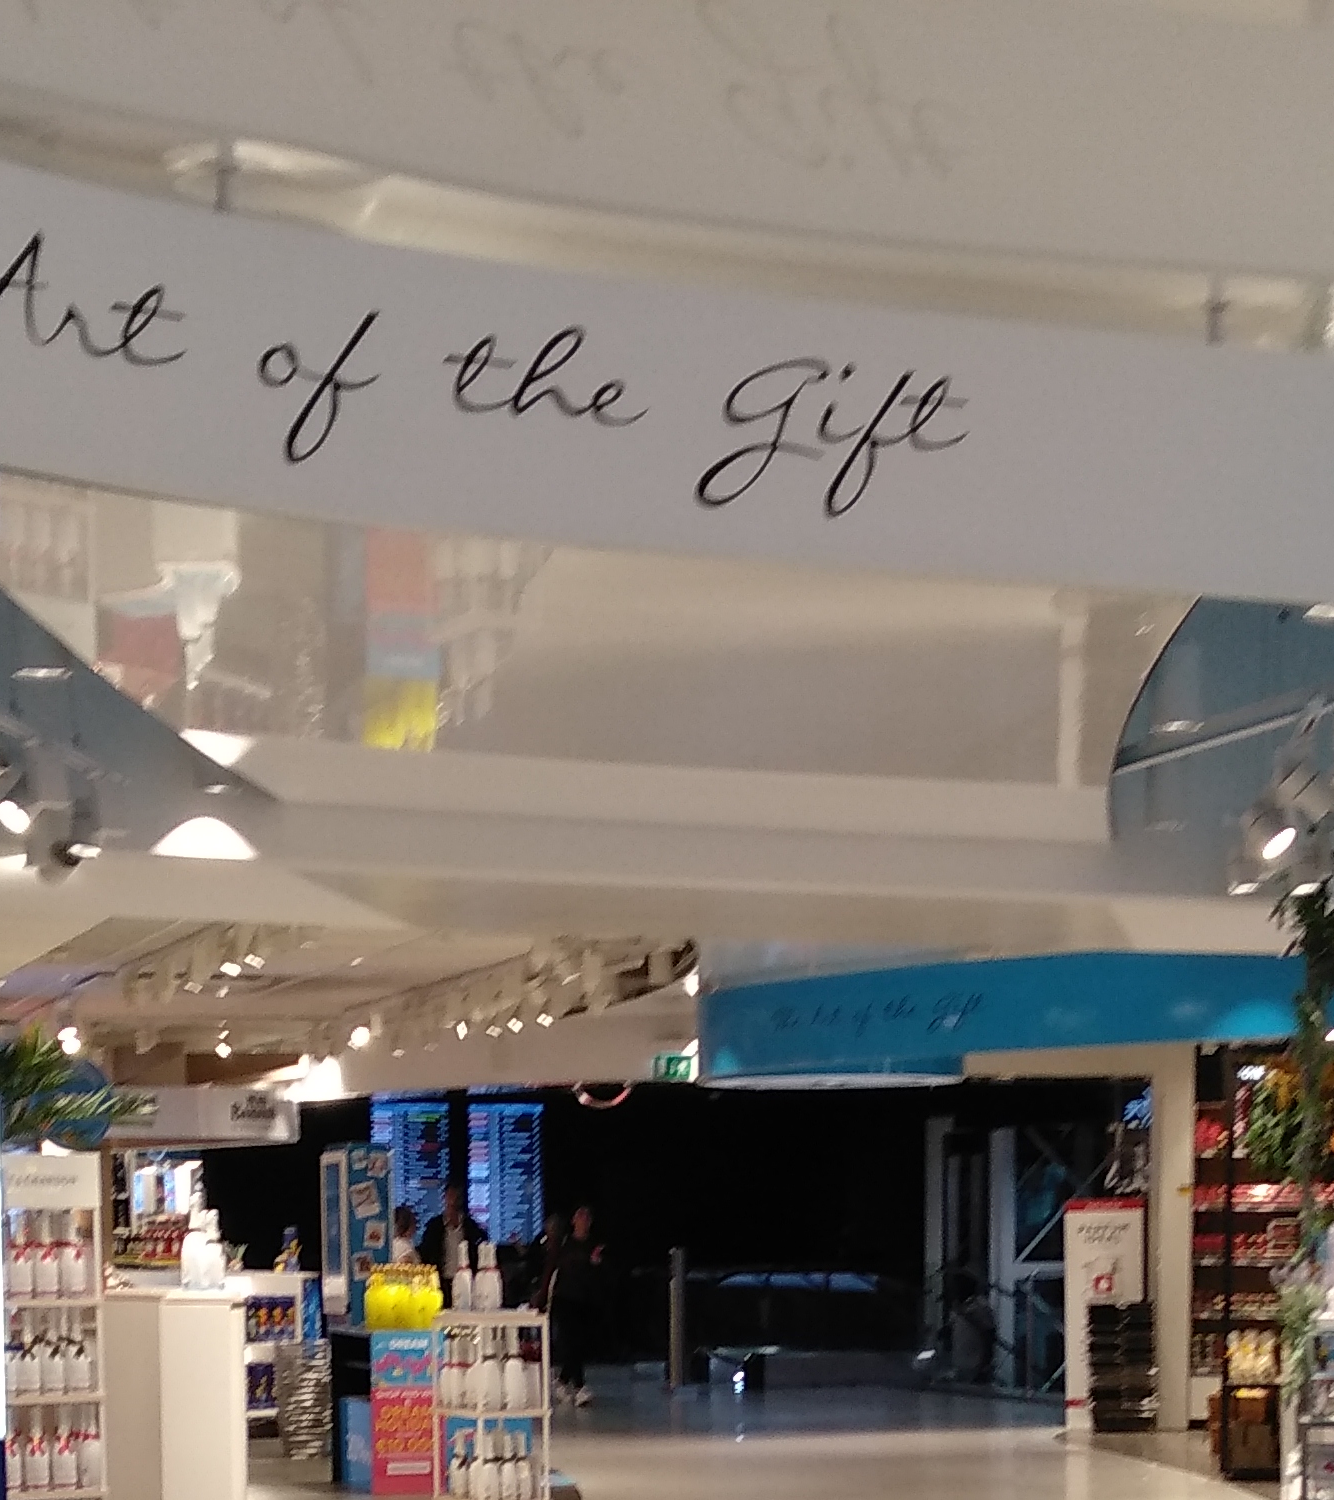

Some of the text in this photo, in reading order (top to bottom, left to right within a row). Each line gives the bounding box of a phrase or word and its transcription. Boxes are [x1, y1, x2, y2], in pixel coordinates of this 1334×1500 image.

[257, 309, 380, 464] of
[442, 324, 649, 429] the
[694, 356, 971, 518] Gift
